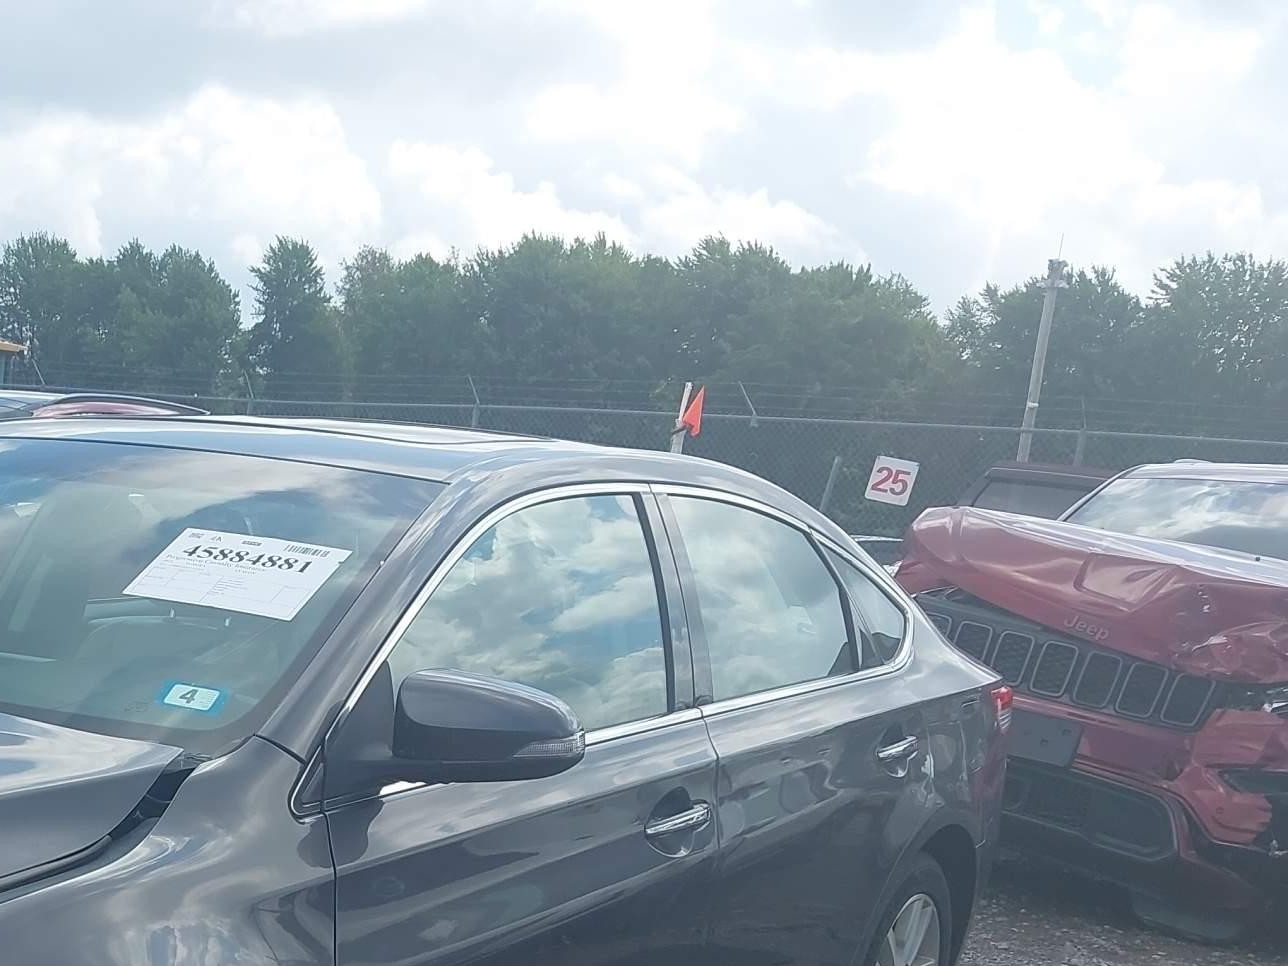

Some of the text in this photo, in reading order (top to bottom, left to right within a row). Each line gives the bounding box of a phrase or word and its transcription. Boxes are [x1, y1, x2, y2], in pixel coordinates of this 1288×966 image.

[871, 466, 911, 495] 25
[183, 545, 312, 573] 45884881
[1063, 615, 1109, 642] Jeep
[178, 688, 198, 704] 4
